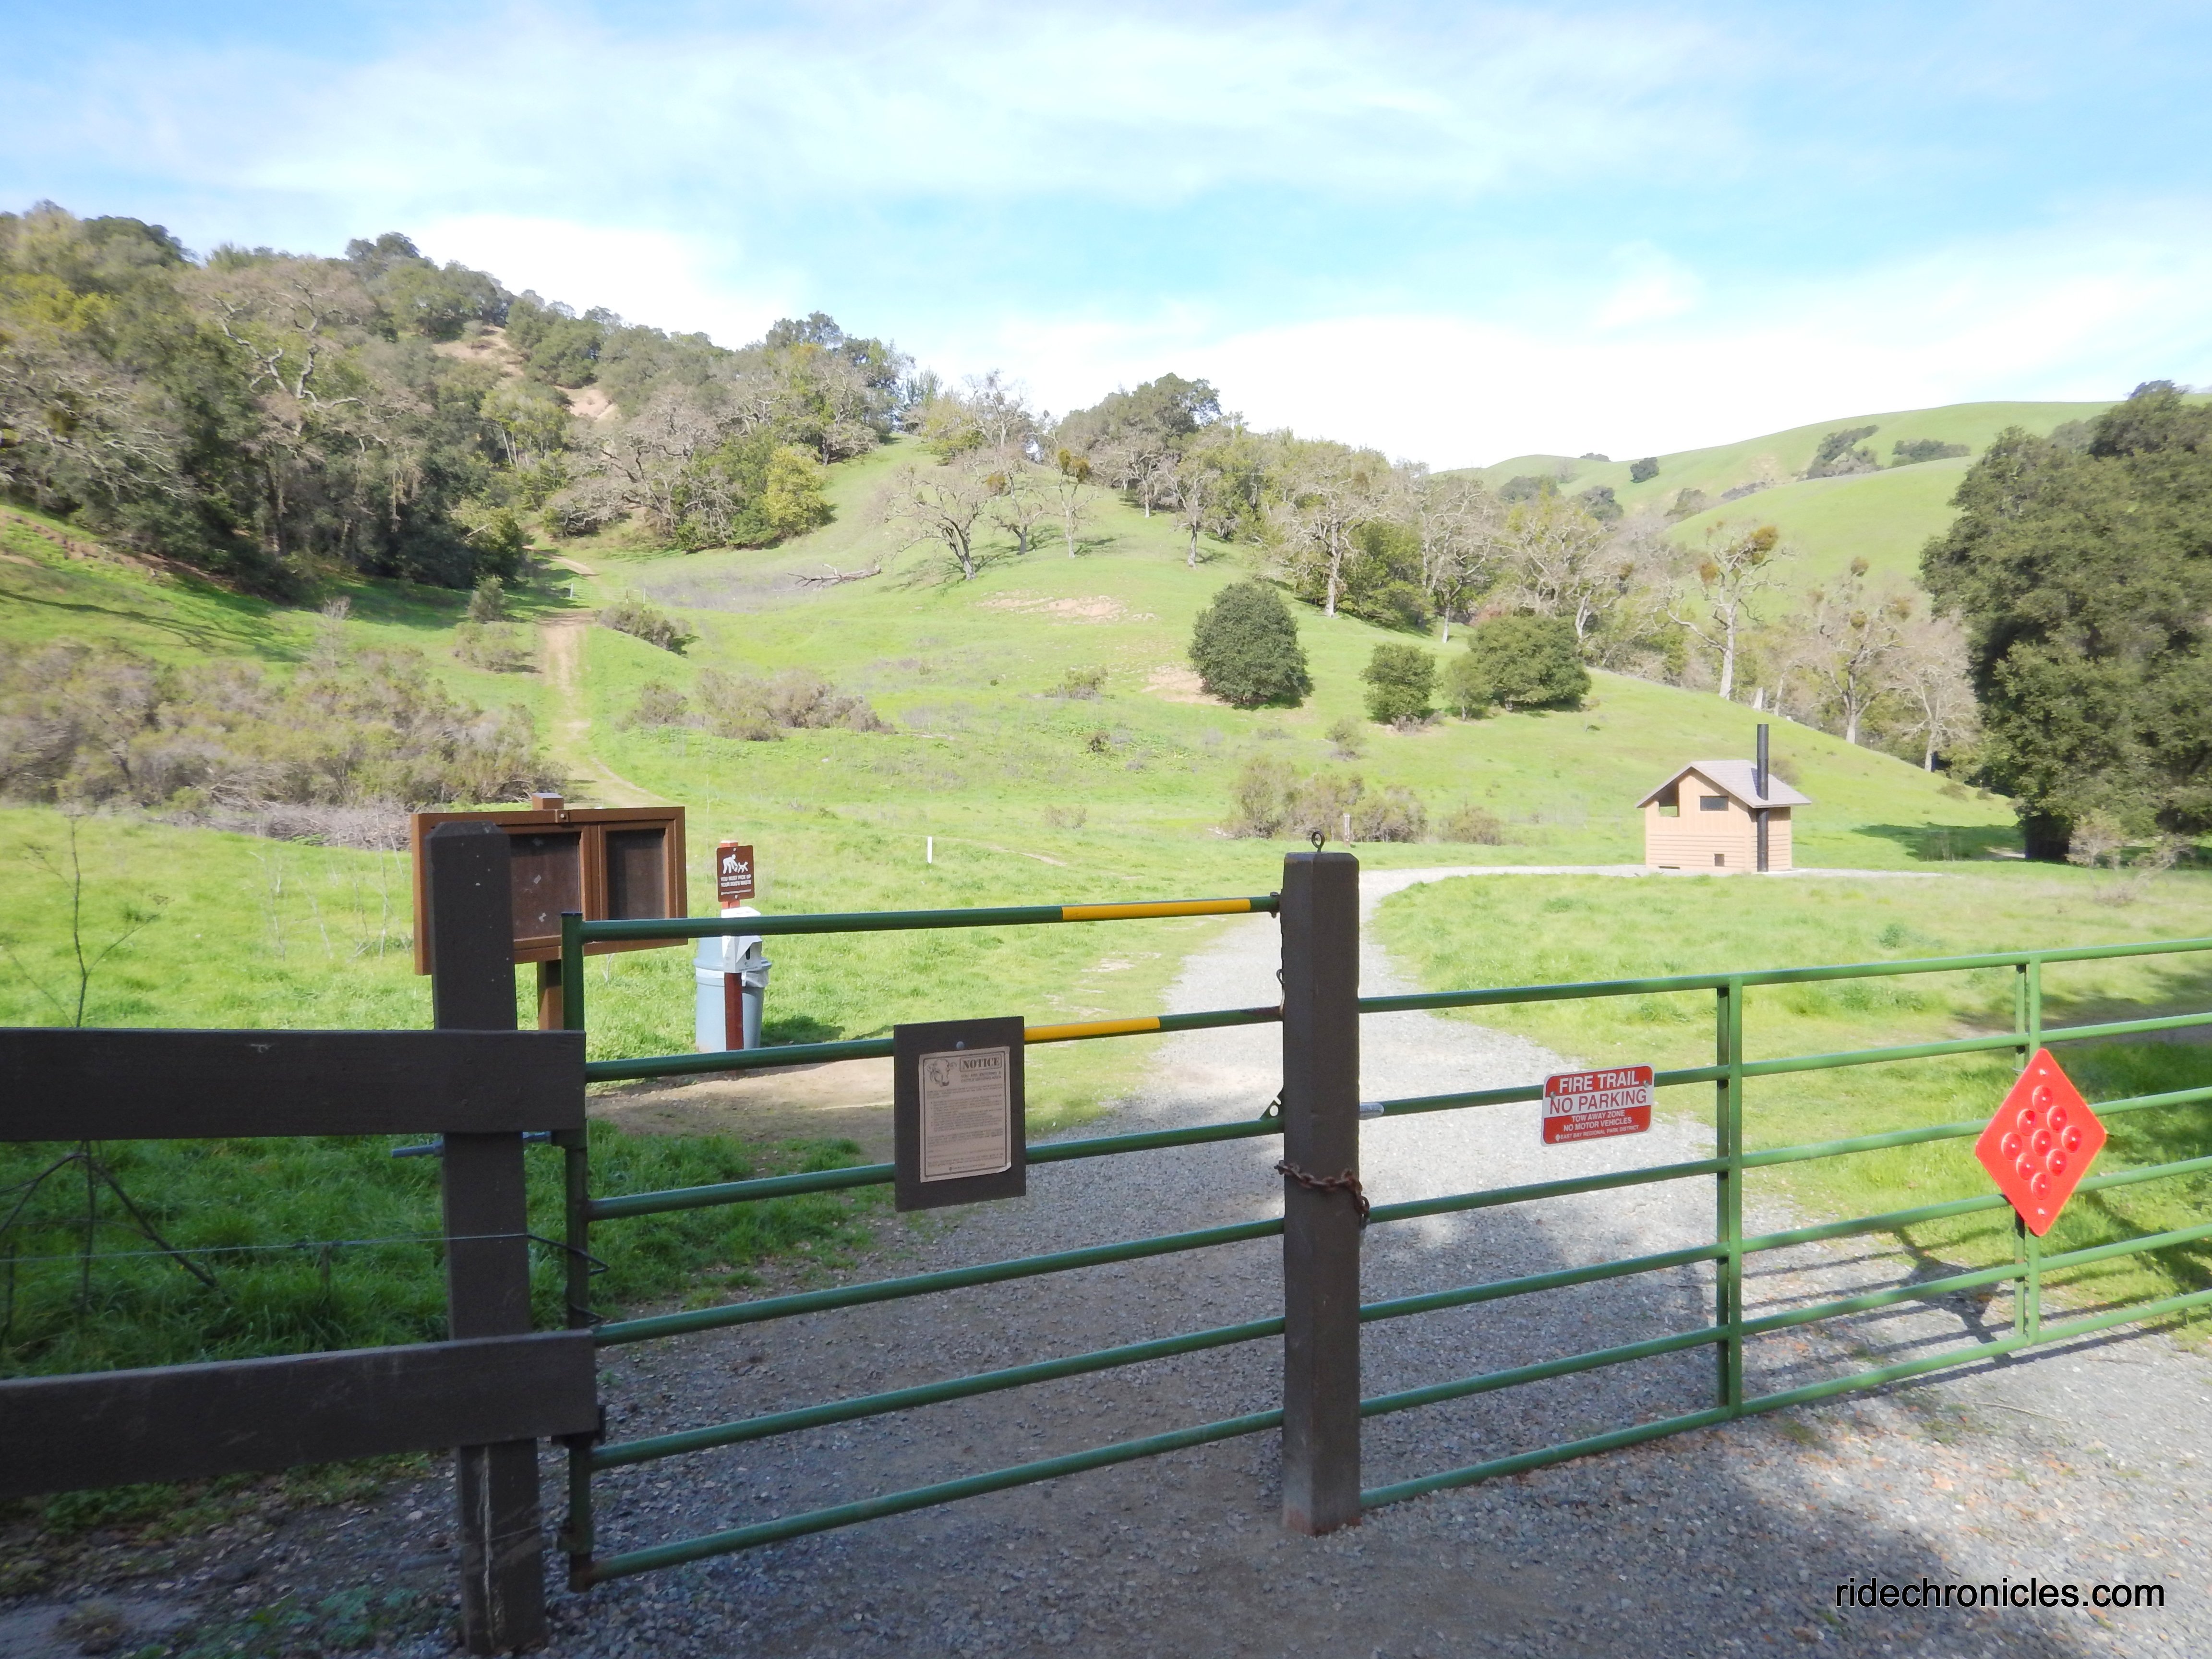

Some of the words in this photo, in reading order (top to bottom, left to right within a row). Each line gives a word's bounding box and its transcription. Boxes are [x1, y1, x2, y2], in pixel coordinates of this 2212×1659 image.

[963, 1057, 1000, 1069] NOTICE
[1559, 1075, 1593, 1094] FIRE
[1598, 1070, 1639, 1089] TRAIL
[1550, 1097, 1573, 1115] NO
[1578, 1088, 1647, 1111] PARKING
[1572, 1114, 1587, 1122] TOW
[1587, 1112, 1606, 1121] AWAY
[1608, 1109, 1625, 1118] ZONE
[1575, 1121, 1599, 1130] MOTOR
[1600, 1117, 1632, 1127] VEHICLES
